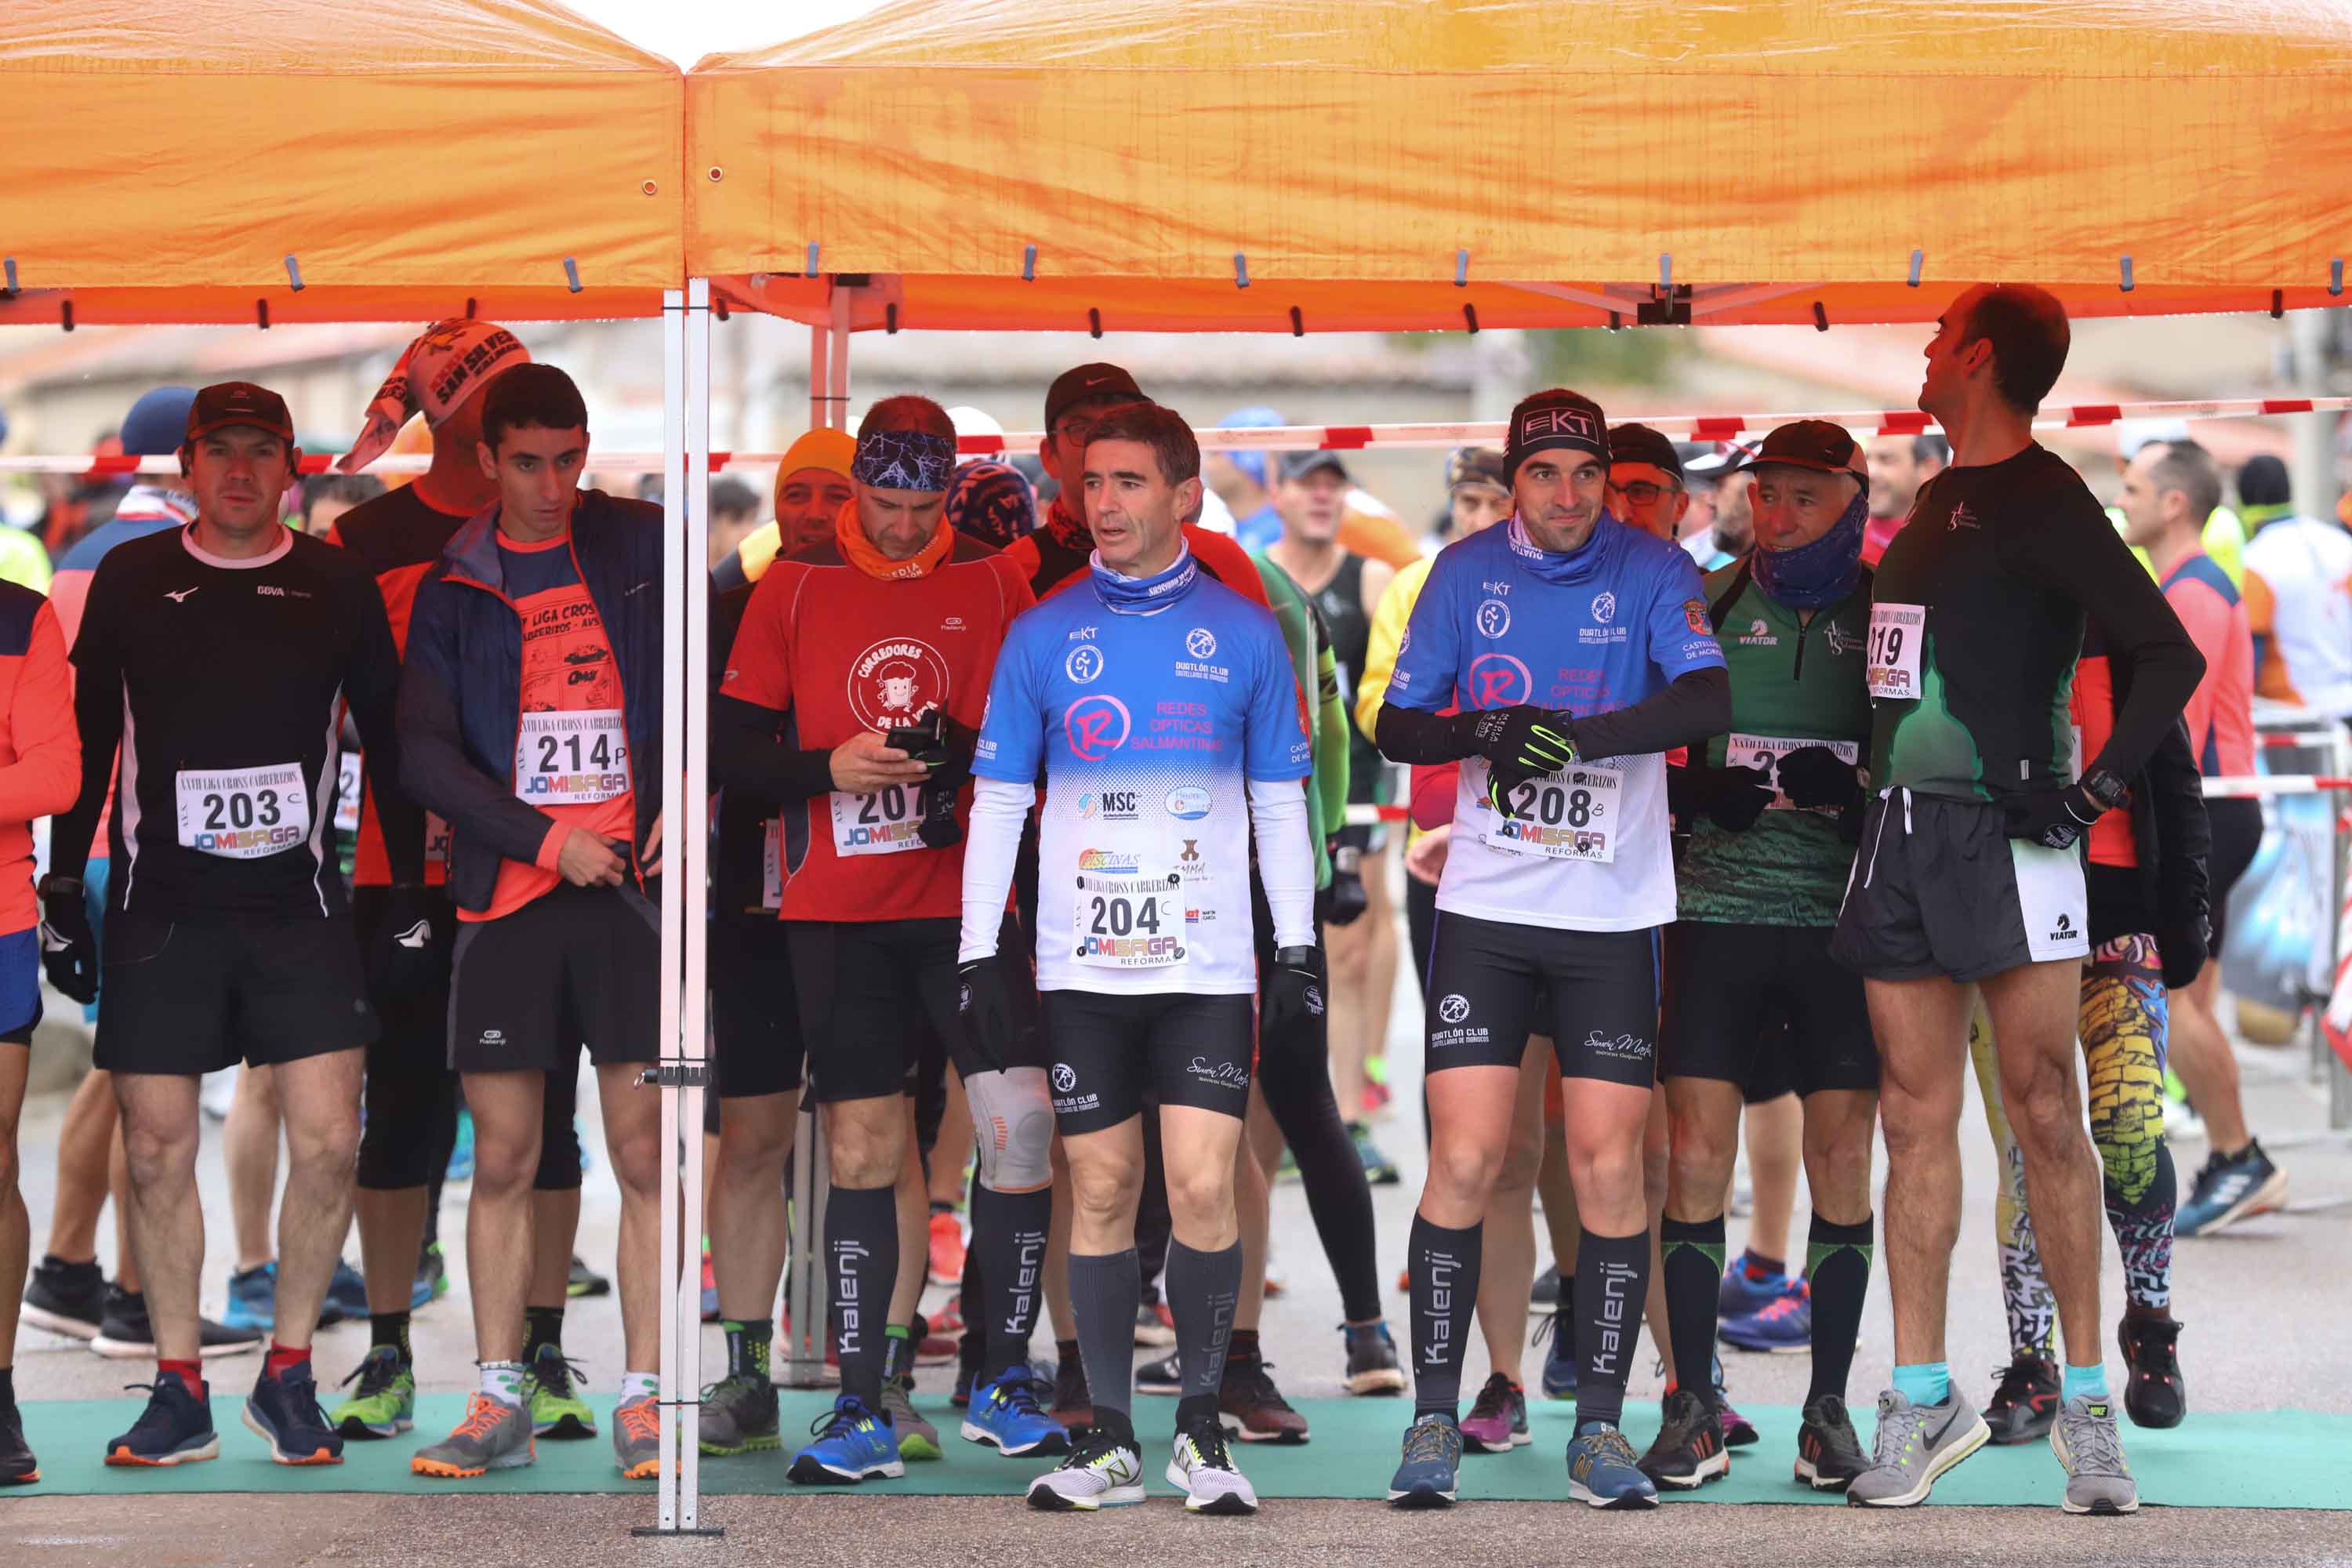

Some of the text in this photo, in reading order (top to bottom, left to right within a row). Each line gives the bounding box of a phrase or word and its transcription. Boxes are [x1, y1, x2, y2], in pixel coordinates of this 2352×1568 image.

[435, 364, 470, 406] SAN
[1526, 410, 1591, 436] EKT
[257, 586, 285, 597] BBVA
[1483, 581, 1512, 596] EKT
[532, 609, 558, 627] LIGA
[1069, 626, 1099, 641] EKT
[1739, 636, 1778, 646] VIATOR
[858, 644, 923, 678] CORREDORES
[1210, 664, 1229, 677] CLUB
[1156, 701, 1207, 716] REDES
[557, 717, 584, 732] CROSS
[584, 715, 622, 731] CABRERIZ
[877, 715, 892, 729] DE
[895, 716, 912, 728] LA
[1150, 719, 1214, 735] OPTICAS
[537, 733, 612, 774] 214
[221, 774, 249, 789] CROSS
[249, 771, 298, 787] CABRERIZOS
[524, 773, 627, 794] JOMISAGA
[202, 789, 281, 831] 203
[855, 782, 927, 824] 207
[1102, 791, 1136, 812] MSC
[1514, 782, 1592, 828] 208
[844, 820, 922, 846] JOMISA
[1495, 819, 1606, 851] JOMISAGA
[1544, 846, 1603, 860] REFORMAS
[1091, 895, 1160, 937] 204
[2050, 929, 2078, 942] VIATOR
[1466, 1027, 1488, 1036] CLUB
[1077, 1093, 1098, 1105] CLUB
